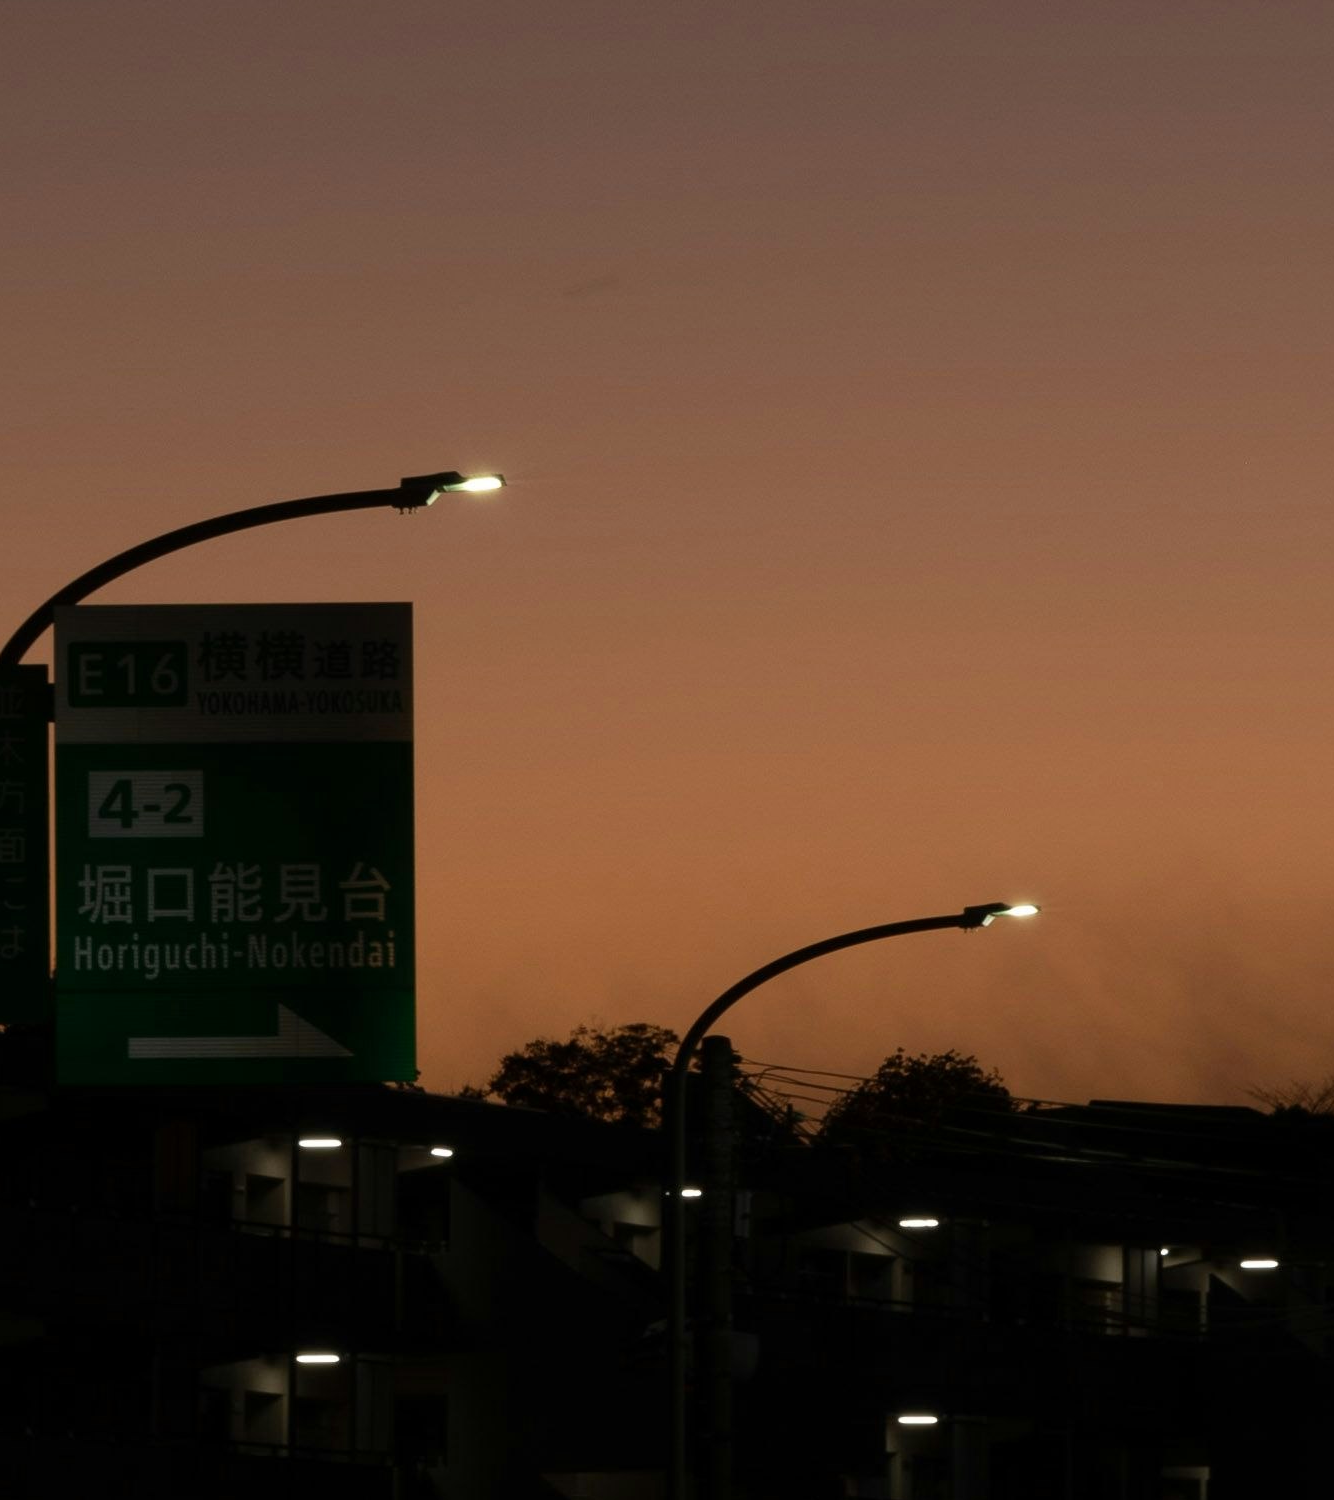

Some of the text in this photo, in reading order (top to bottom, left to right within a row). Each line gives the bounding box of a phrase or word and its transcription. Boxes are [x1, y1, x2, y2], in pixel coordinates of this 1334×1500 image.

[76, 650, 180, 697] E16
[197, 630, 401, 682] 横横道路
[197, 690, 404, 716] YOKOHAMA-YOKOSUKA
[97, 778, 194, 829] 4-2
[76, 860, 394, 925] 堀口能見台
[73, 929, 397, 982] Horiguchi-Nokendai
